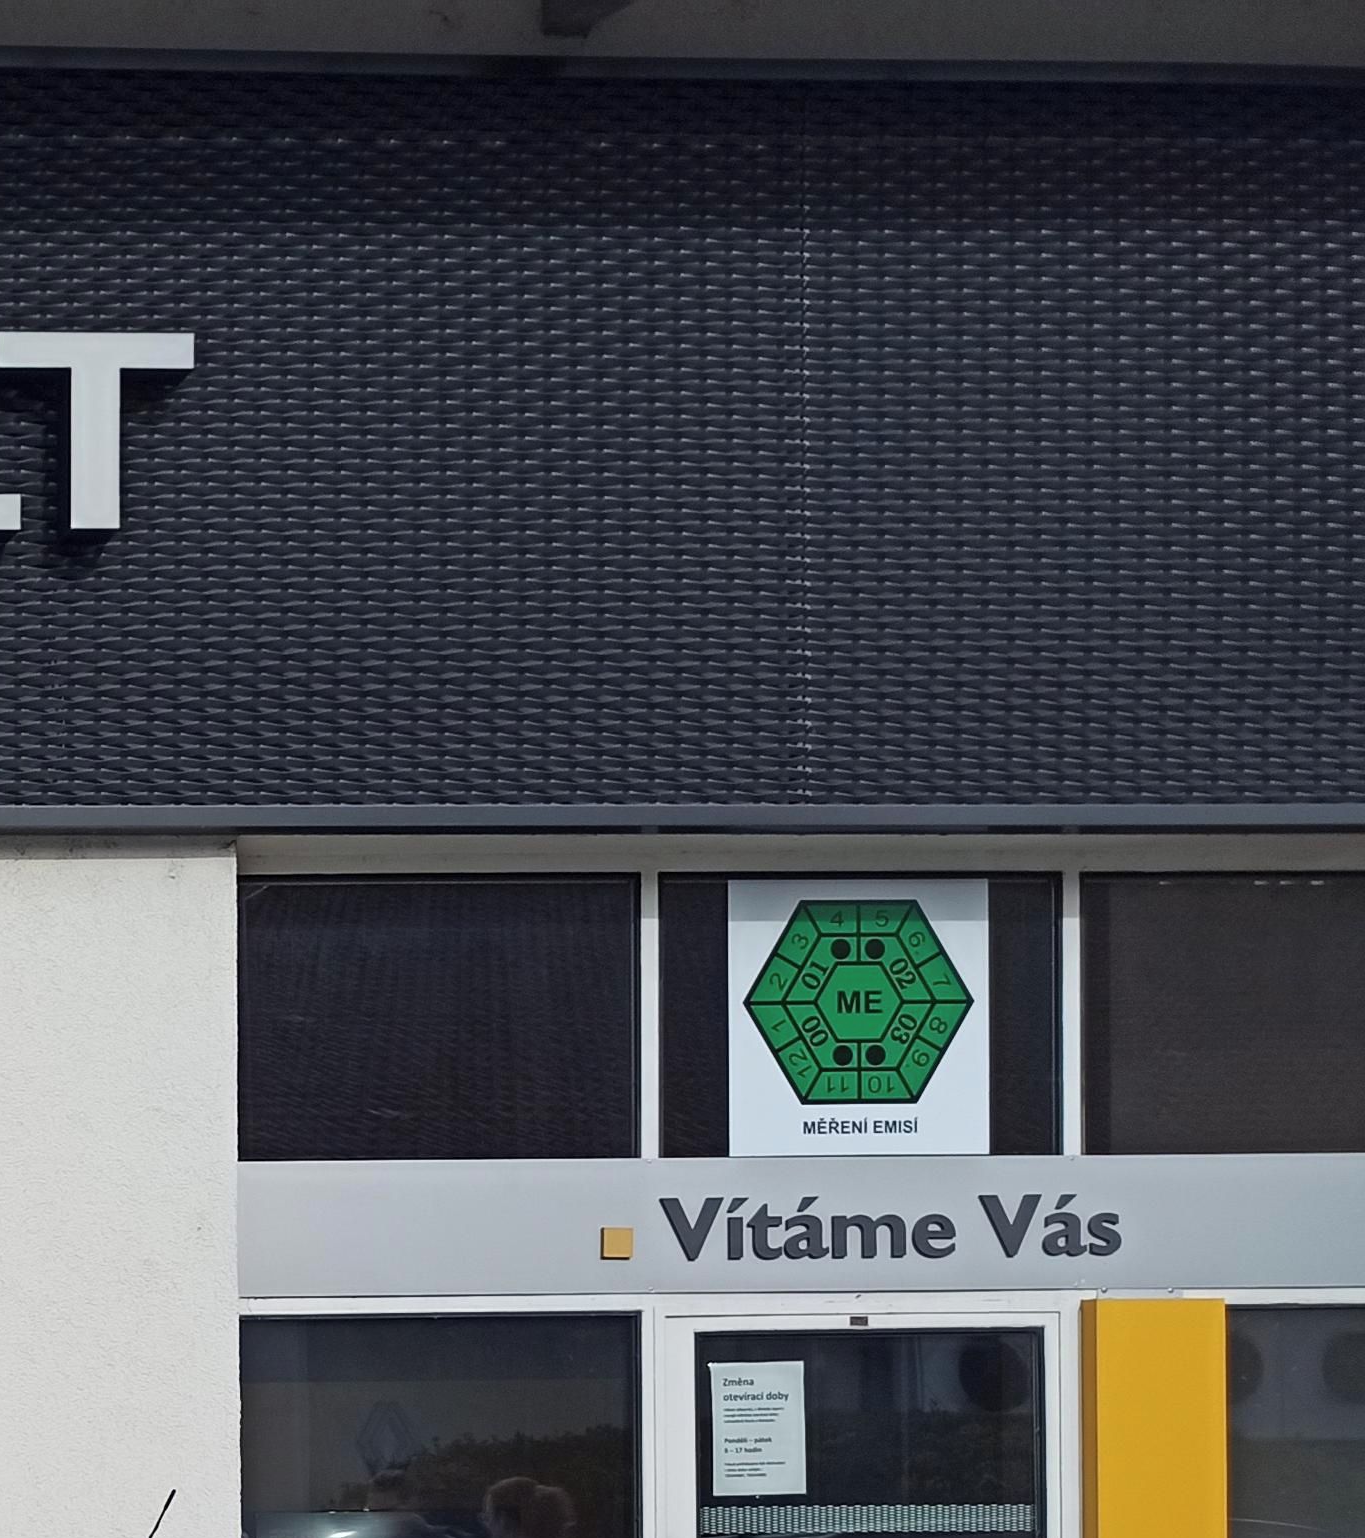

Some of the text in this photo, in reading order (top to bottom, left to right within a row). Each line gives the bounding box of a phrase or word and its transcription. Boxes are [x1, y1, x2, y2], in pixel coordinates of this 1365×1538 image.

[829, 911, 844, 926] 4
[874, 911, 890, 927] 5
[791, 932, 810, 950] 3
[769, 972, 788, 991] 2
[836, 990, 884, 1014] ME
[929, 1016, 948, 1035] 8
[802, 1116, 918, 1135] MĚŘENÍ EMISÍ
[659, 1193, 1123, 1261] Vítáme Vás
[722, 1377, 755, 1387] Změna
[765, 1391, 790, 1402] doby
